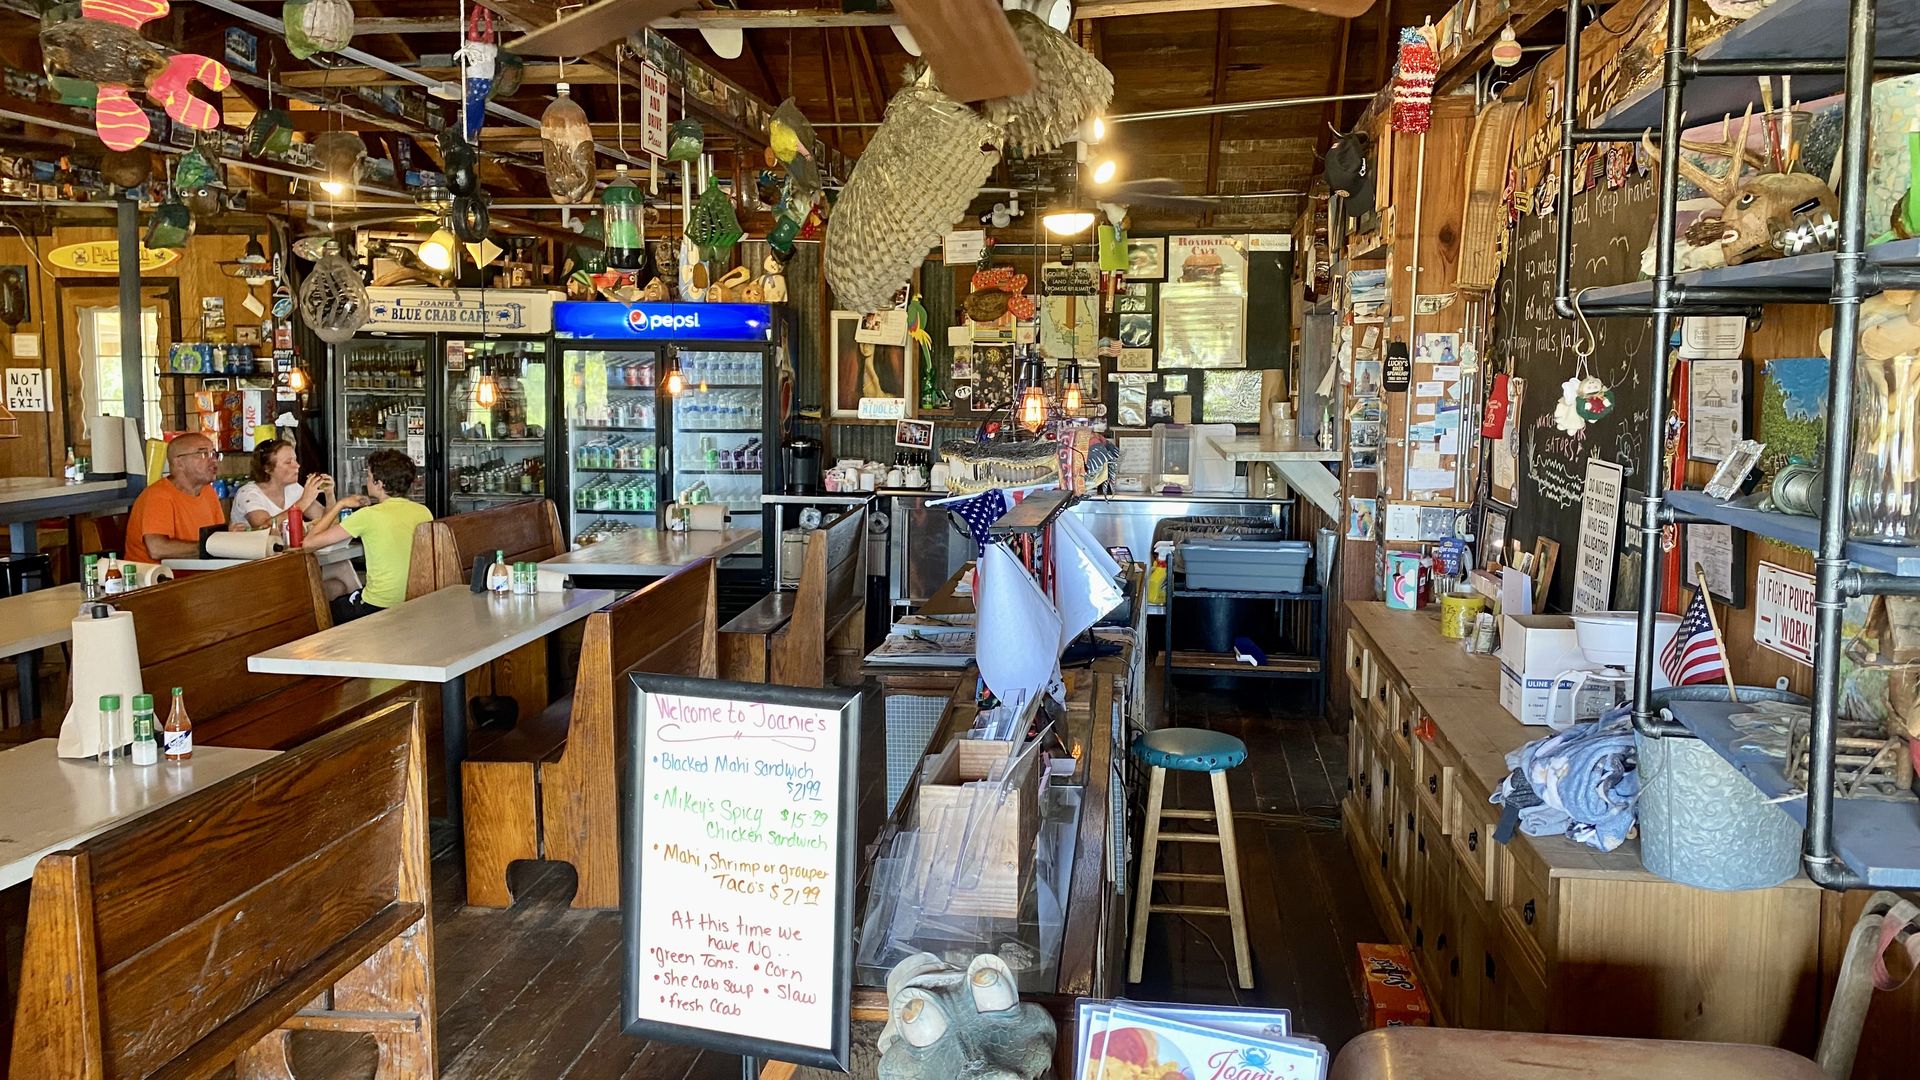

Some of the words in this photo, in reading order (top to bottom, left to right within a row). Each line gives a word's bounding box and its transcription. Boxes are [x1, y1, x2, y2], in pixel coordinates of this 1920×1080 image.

[644, 73, 658, 93] HANG
[658, 81, 666, 97] UP
[650, 95, 660, 112] AND
[648, 112, 662, 131] DRIVE
[1595, 185, 1619, 224] Keep
[391, 308, 422, 320] BLUE
[425, 310, 457, 321] CRAB
[418, 300, 463, 308] JOANIE'S
[649, 312, 700, 331] pepsi
[1534, 324, 1559, 357] Trails,
[10, 374, 40, 385] NOT
[10, 398, 42, 408] EXIT
[16, 388, 33, 397] AN
[862, 404, 899, 415] RIDDLES
[244, 405, 256, 437] Coke
[1588, 477, 1595, 492] DO
[1595, 480, 1604, 496] NOT
[1604, 482, 1616, 499] FEED
[1594, 498, 1615, 519] TOURISTS
[1587, 514, 1597, 532] WHO
[1598, 518, 1609, 537] FEED
[1439, 545, 1459, 554] Corona
[1583, 532, 1609, 558] ALLIGATORS
[1584, 551, 1594, 569] WHO
[1594, 555, 1604, 574] EAT
[1582, 569, 1603, 594] TOURISTS
[1767, 578, 1787, 607] FIGHT
[1576, 586, 1590, 606] WHICH
[1780, 614, 1813, 650] WORK!
[655, 694, 722, 725] Welcome
[728, 702, 746, 724] to
[750, 703, 827, 733] Joanie's
[661, 752, 708, 774] Blacked
[714, 755, 749, 774] Mahi
[720, 799, 763, 831] Spicy
[706, 820, 763, 844] Chicken
[712, 873, 765, 895] Taco's
[763, 865, 776, 875] or
[779, 863, 830, 885] grouper
[671, 910, 694, 930] At
[698, 913, 730, 933] this
[736, 915, 772, 938] time
[708, 934, 741, 954] have
[655, 947, 696, 969] green
[668, 992, 704, 1013] fresh
[777, 984, 817, 1005] Slaw
